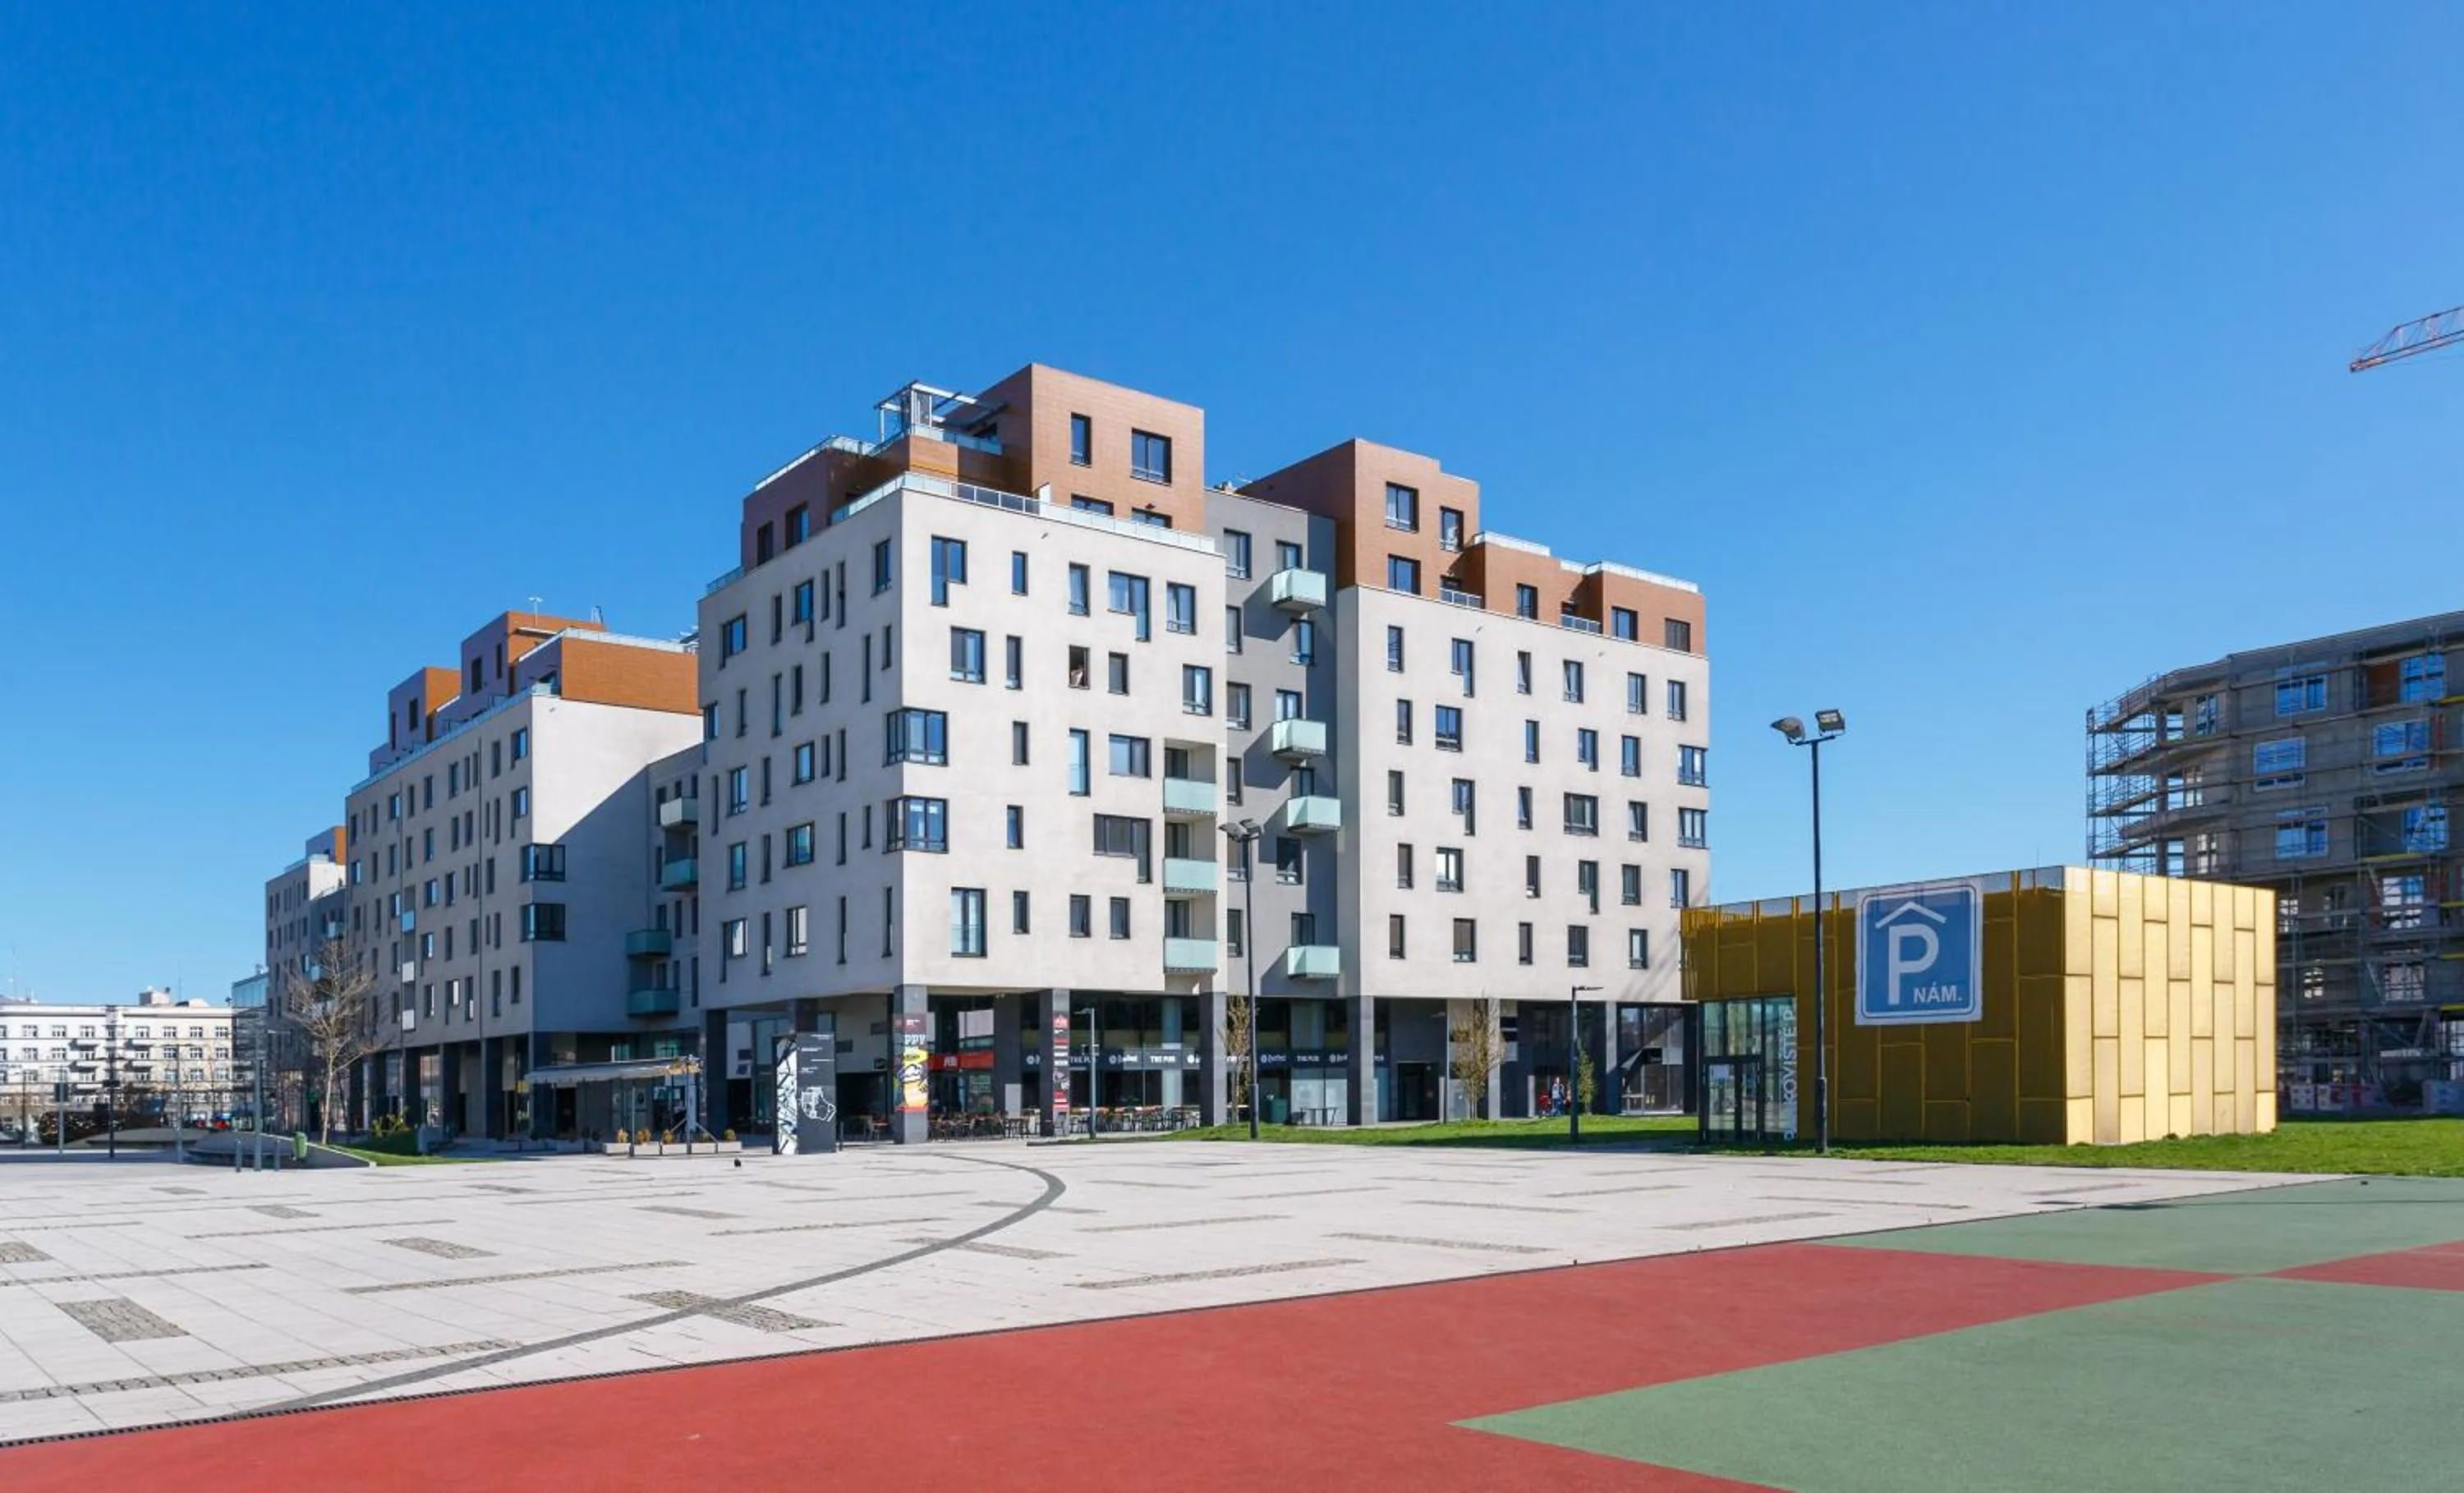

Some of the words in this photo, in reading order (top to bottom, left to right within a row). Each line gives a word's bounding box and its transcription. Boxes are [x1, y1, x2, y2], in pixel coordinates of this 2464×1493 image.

[1888, 923, 1939, 1005] P
[1913, 981, 1962, 1004] NÁM.
[1778, 1027, 1797, 1141] PKOVIŠTĚ
